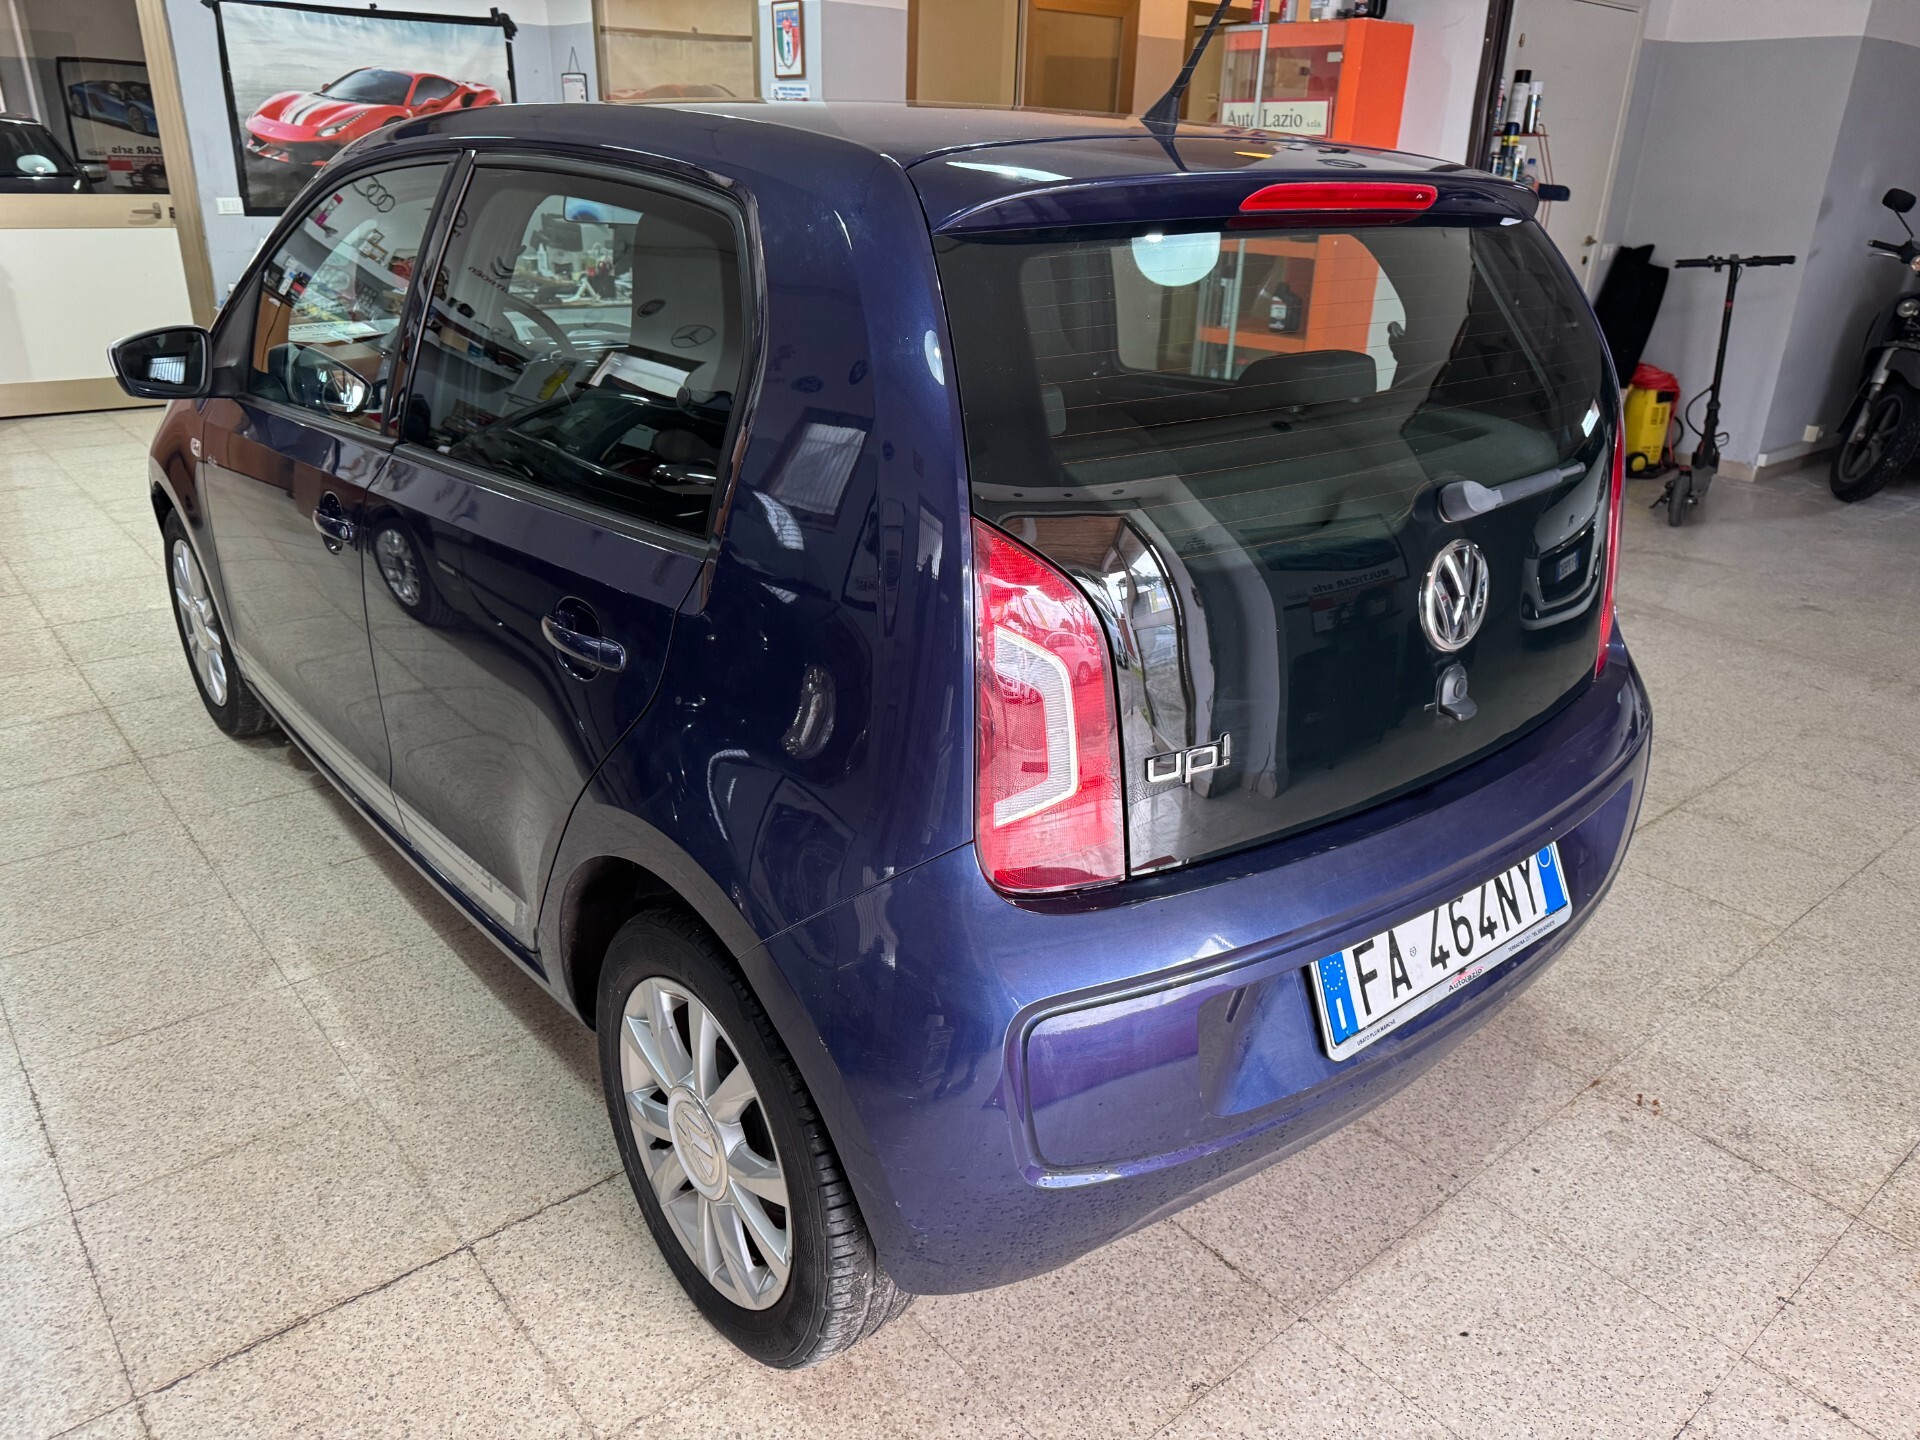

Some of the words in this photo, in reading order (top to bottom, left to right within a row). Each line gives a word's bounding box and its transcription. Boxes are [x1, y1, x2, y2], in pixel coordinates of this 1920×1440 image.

[1263, 108, 1303, 128] Lazio
[1145, 731, 1230, 783] up!
[1353, 929, 1413, 1017] FA
[1430, 858, 1537, 970] 464NY
